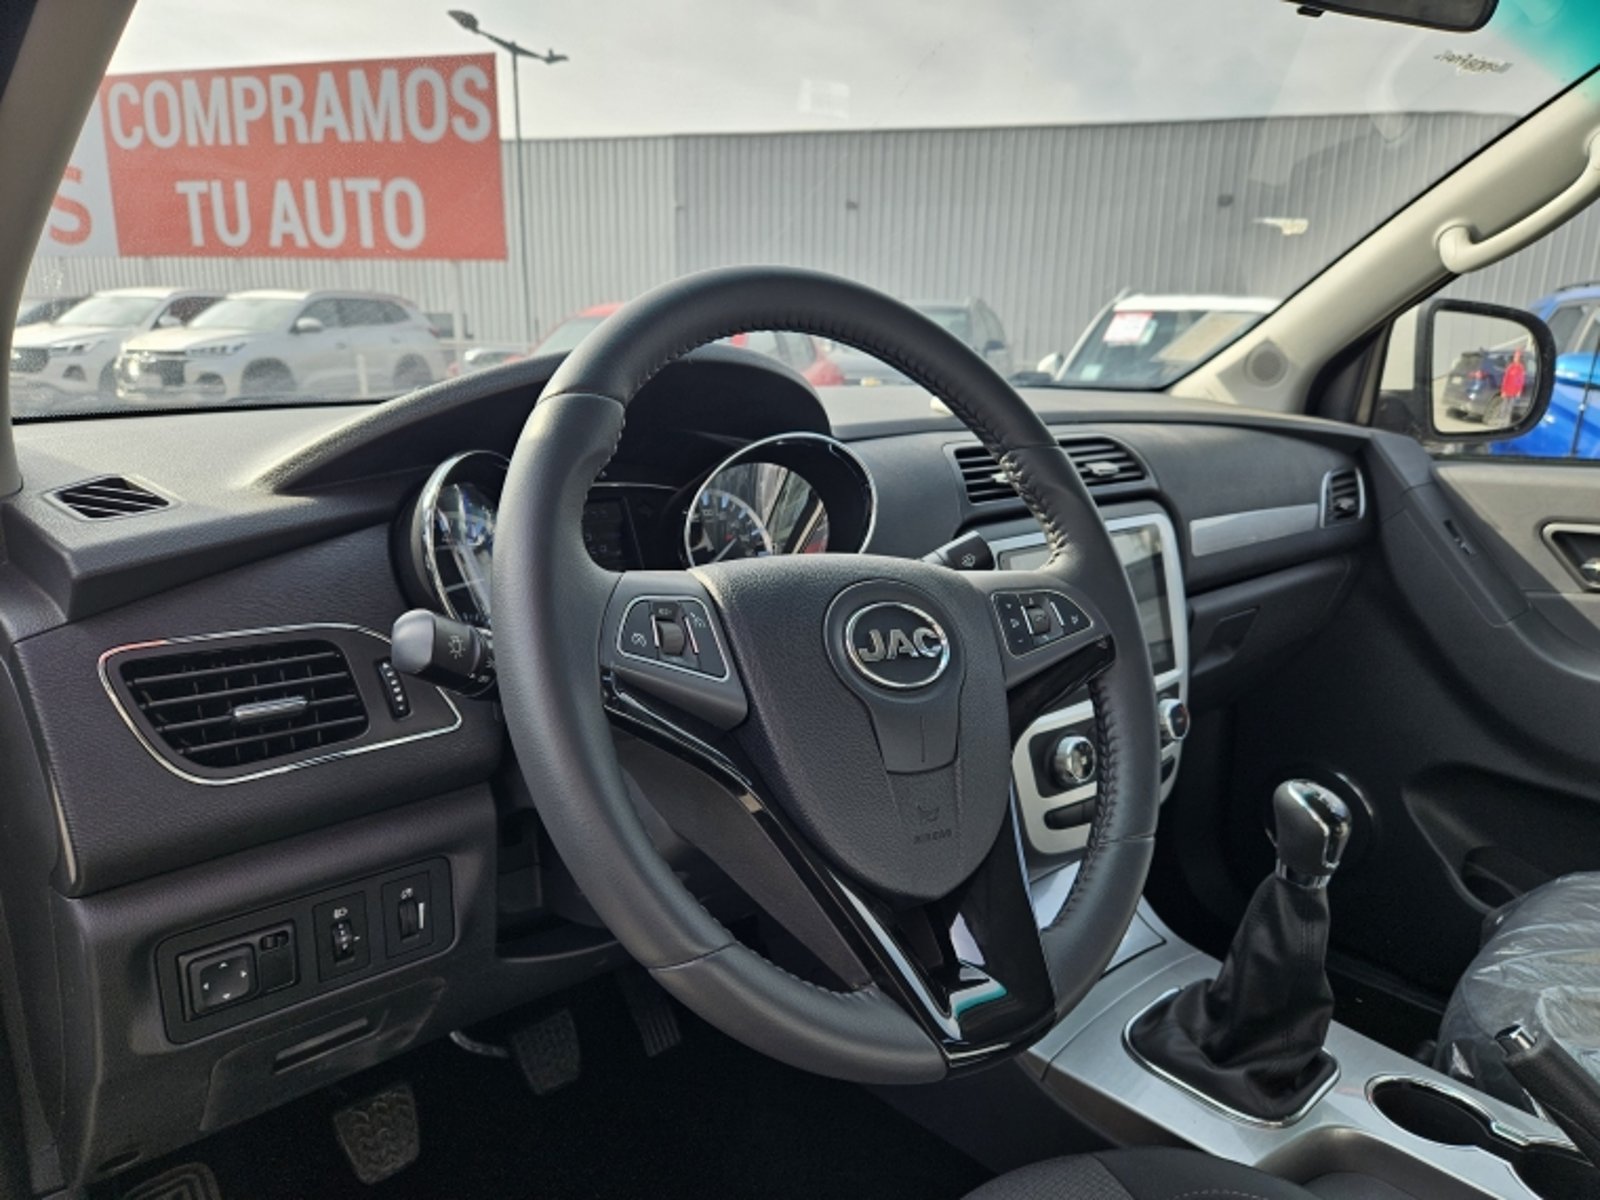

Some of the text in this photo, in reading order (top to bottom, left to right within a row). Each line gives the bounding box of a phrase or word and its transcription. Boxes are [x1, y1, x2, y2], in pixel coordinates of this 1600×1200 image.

[107, 64, 492, 150] COMPRAMOS
[174, 175, 427, 250] TU AUTO
[858, 627, 942, 662] JAC
